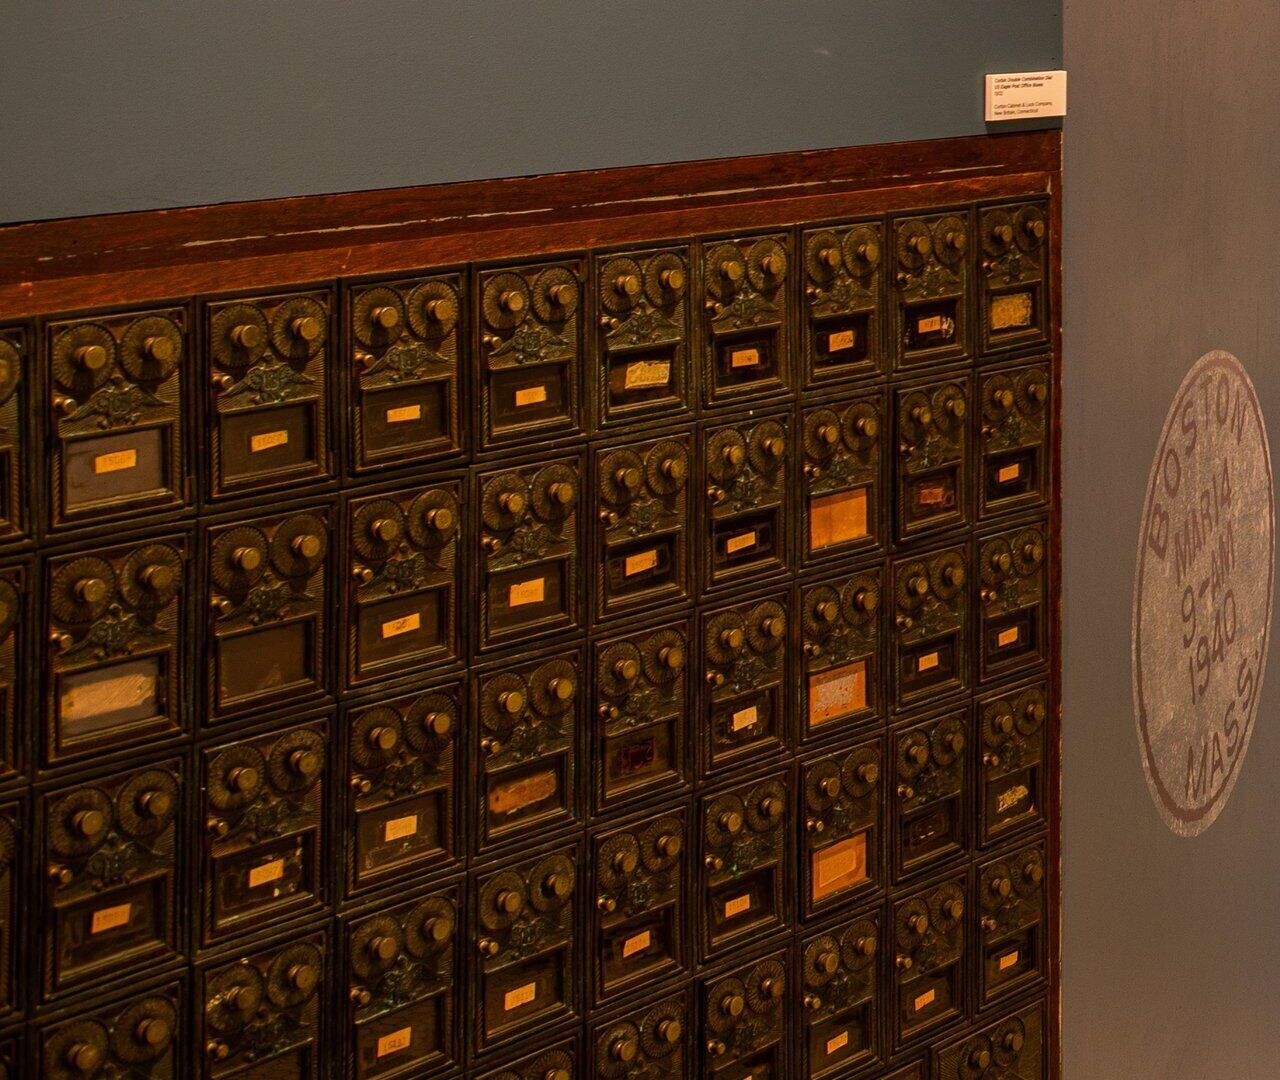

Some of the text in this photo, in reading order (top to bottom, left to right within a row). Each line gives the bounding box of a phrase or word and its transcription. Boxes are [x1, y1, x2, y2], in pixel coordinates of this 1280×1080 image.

[1149, 375, 1248, 561] BOSTON
[1190, 588, 1237, 706] 1940
[1184, 649, 1259, 802] MASS.
